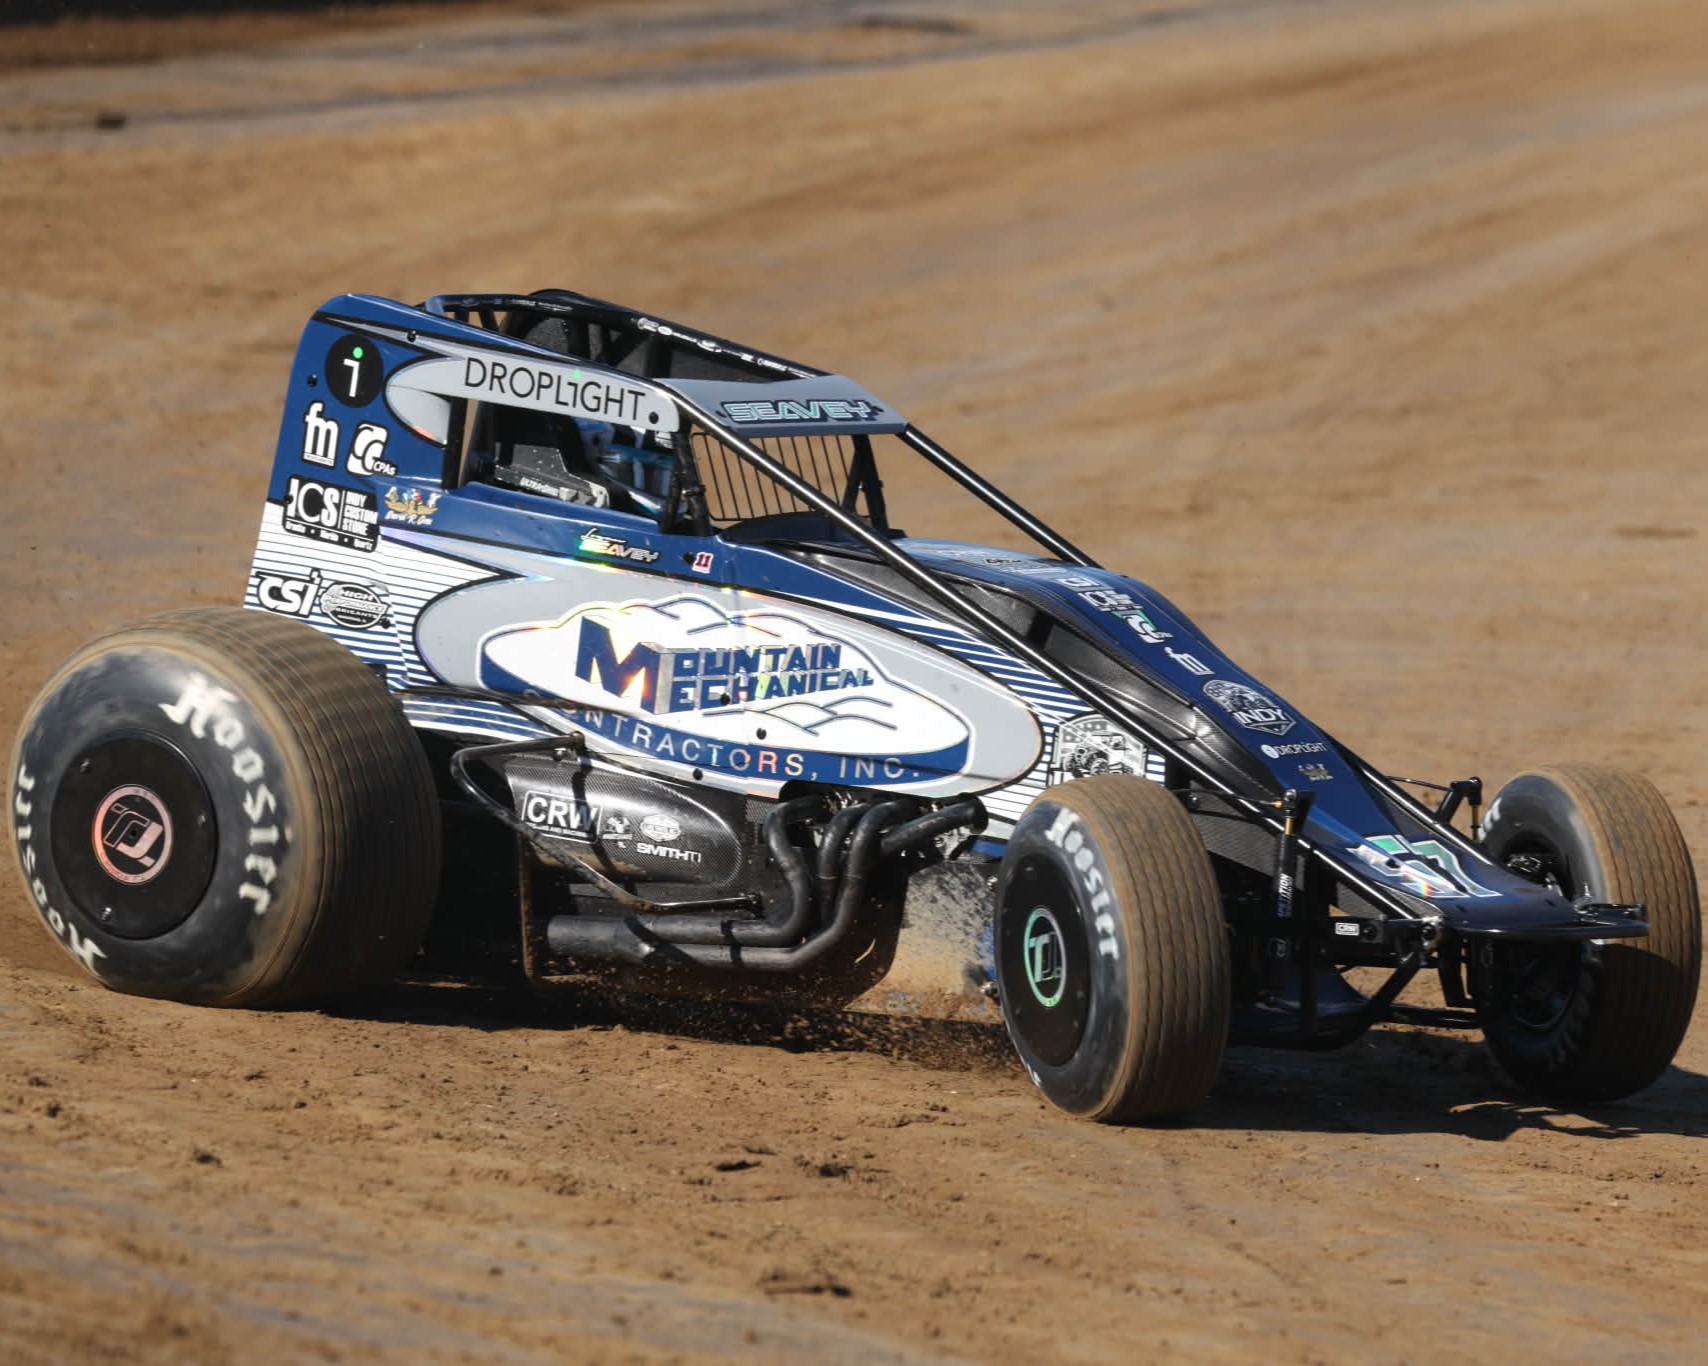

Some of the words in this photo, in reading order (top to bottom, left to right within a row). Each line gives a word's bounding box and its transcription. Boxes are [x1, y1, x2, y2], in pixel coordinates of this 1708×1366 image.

[723, 400, 871, 422] SEAVEY
[1234, 708, 1286, 724] INDY
[522, 688, 818, 782] NTRACTORS,
[839, 755, 921, 781] INC.
[527, 796, 598, 833] CRW
